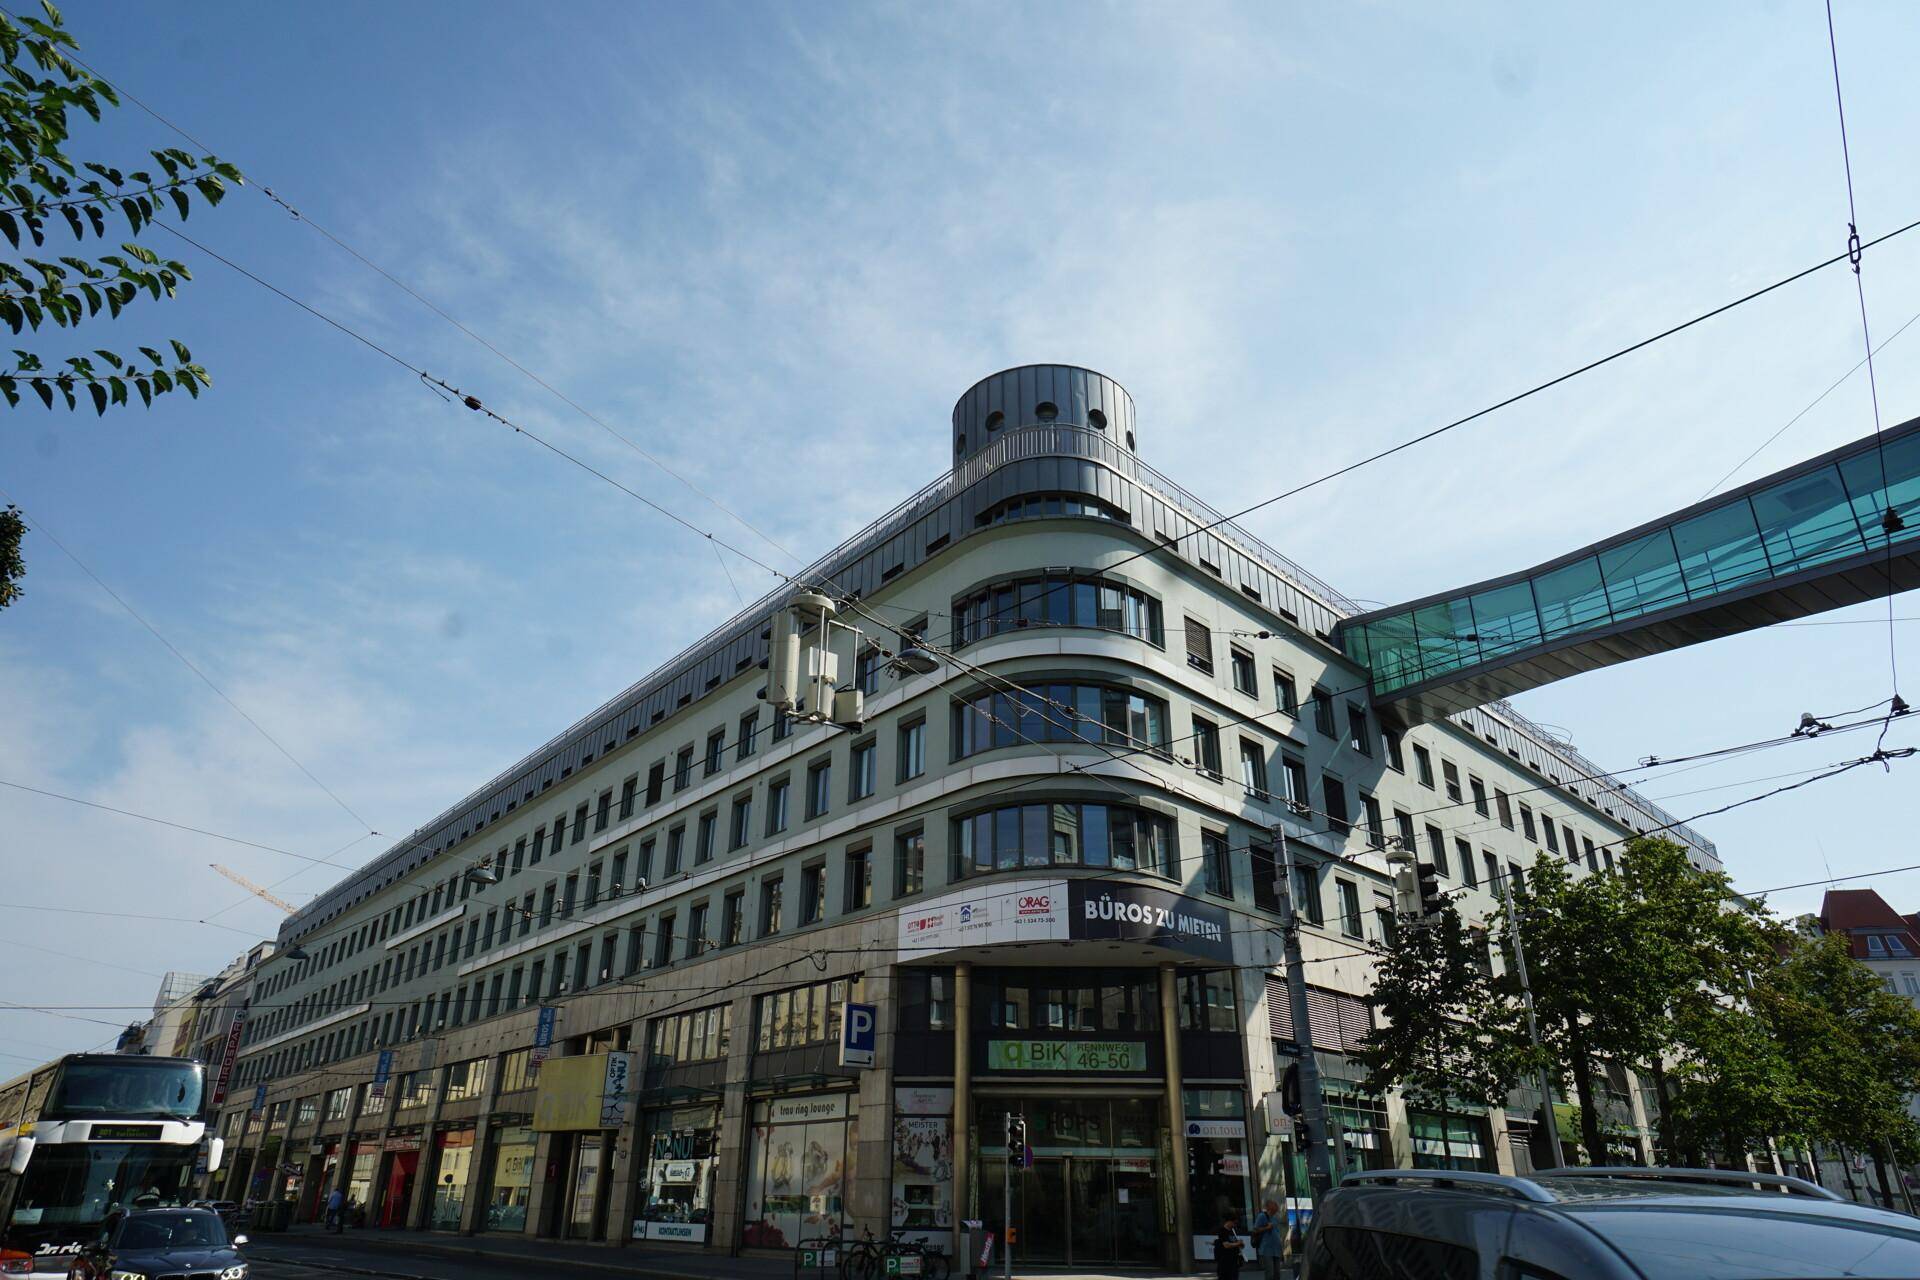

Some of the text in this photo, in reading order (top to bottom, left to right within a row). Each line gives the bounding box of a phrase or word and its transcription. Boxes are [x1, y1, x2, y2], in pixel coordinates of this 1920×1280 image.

[1085, 893, 1222, 942] BÜROS ZU MIETEN
[851, 1010, 872, 1043] P
[1077, 1044, 1129, 1053] RENNWEG
[216, 1022, 242, 1094] EUROSPAR
[1077, 1054, 1130, 1070] 46-50
[609, 1056, 618, 1078] OPTIK
[795, 1103, 809, 1117] ring
[810, 1103, 835, 1115] lounge
[908, 1121, 938, 1129] MEISTER
[1202, 1126, 1243, 1136] on.tour
[656, 1137, 694, 1159] NNU!
[803, 1252, 814, 1266] P
[886, 1258, 897, 1273] P
